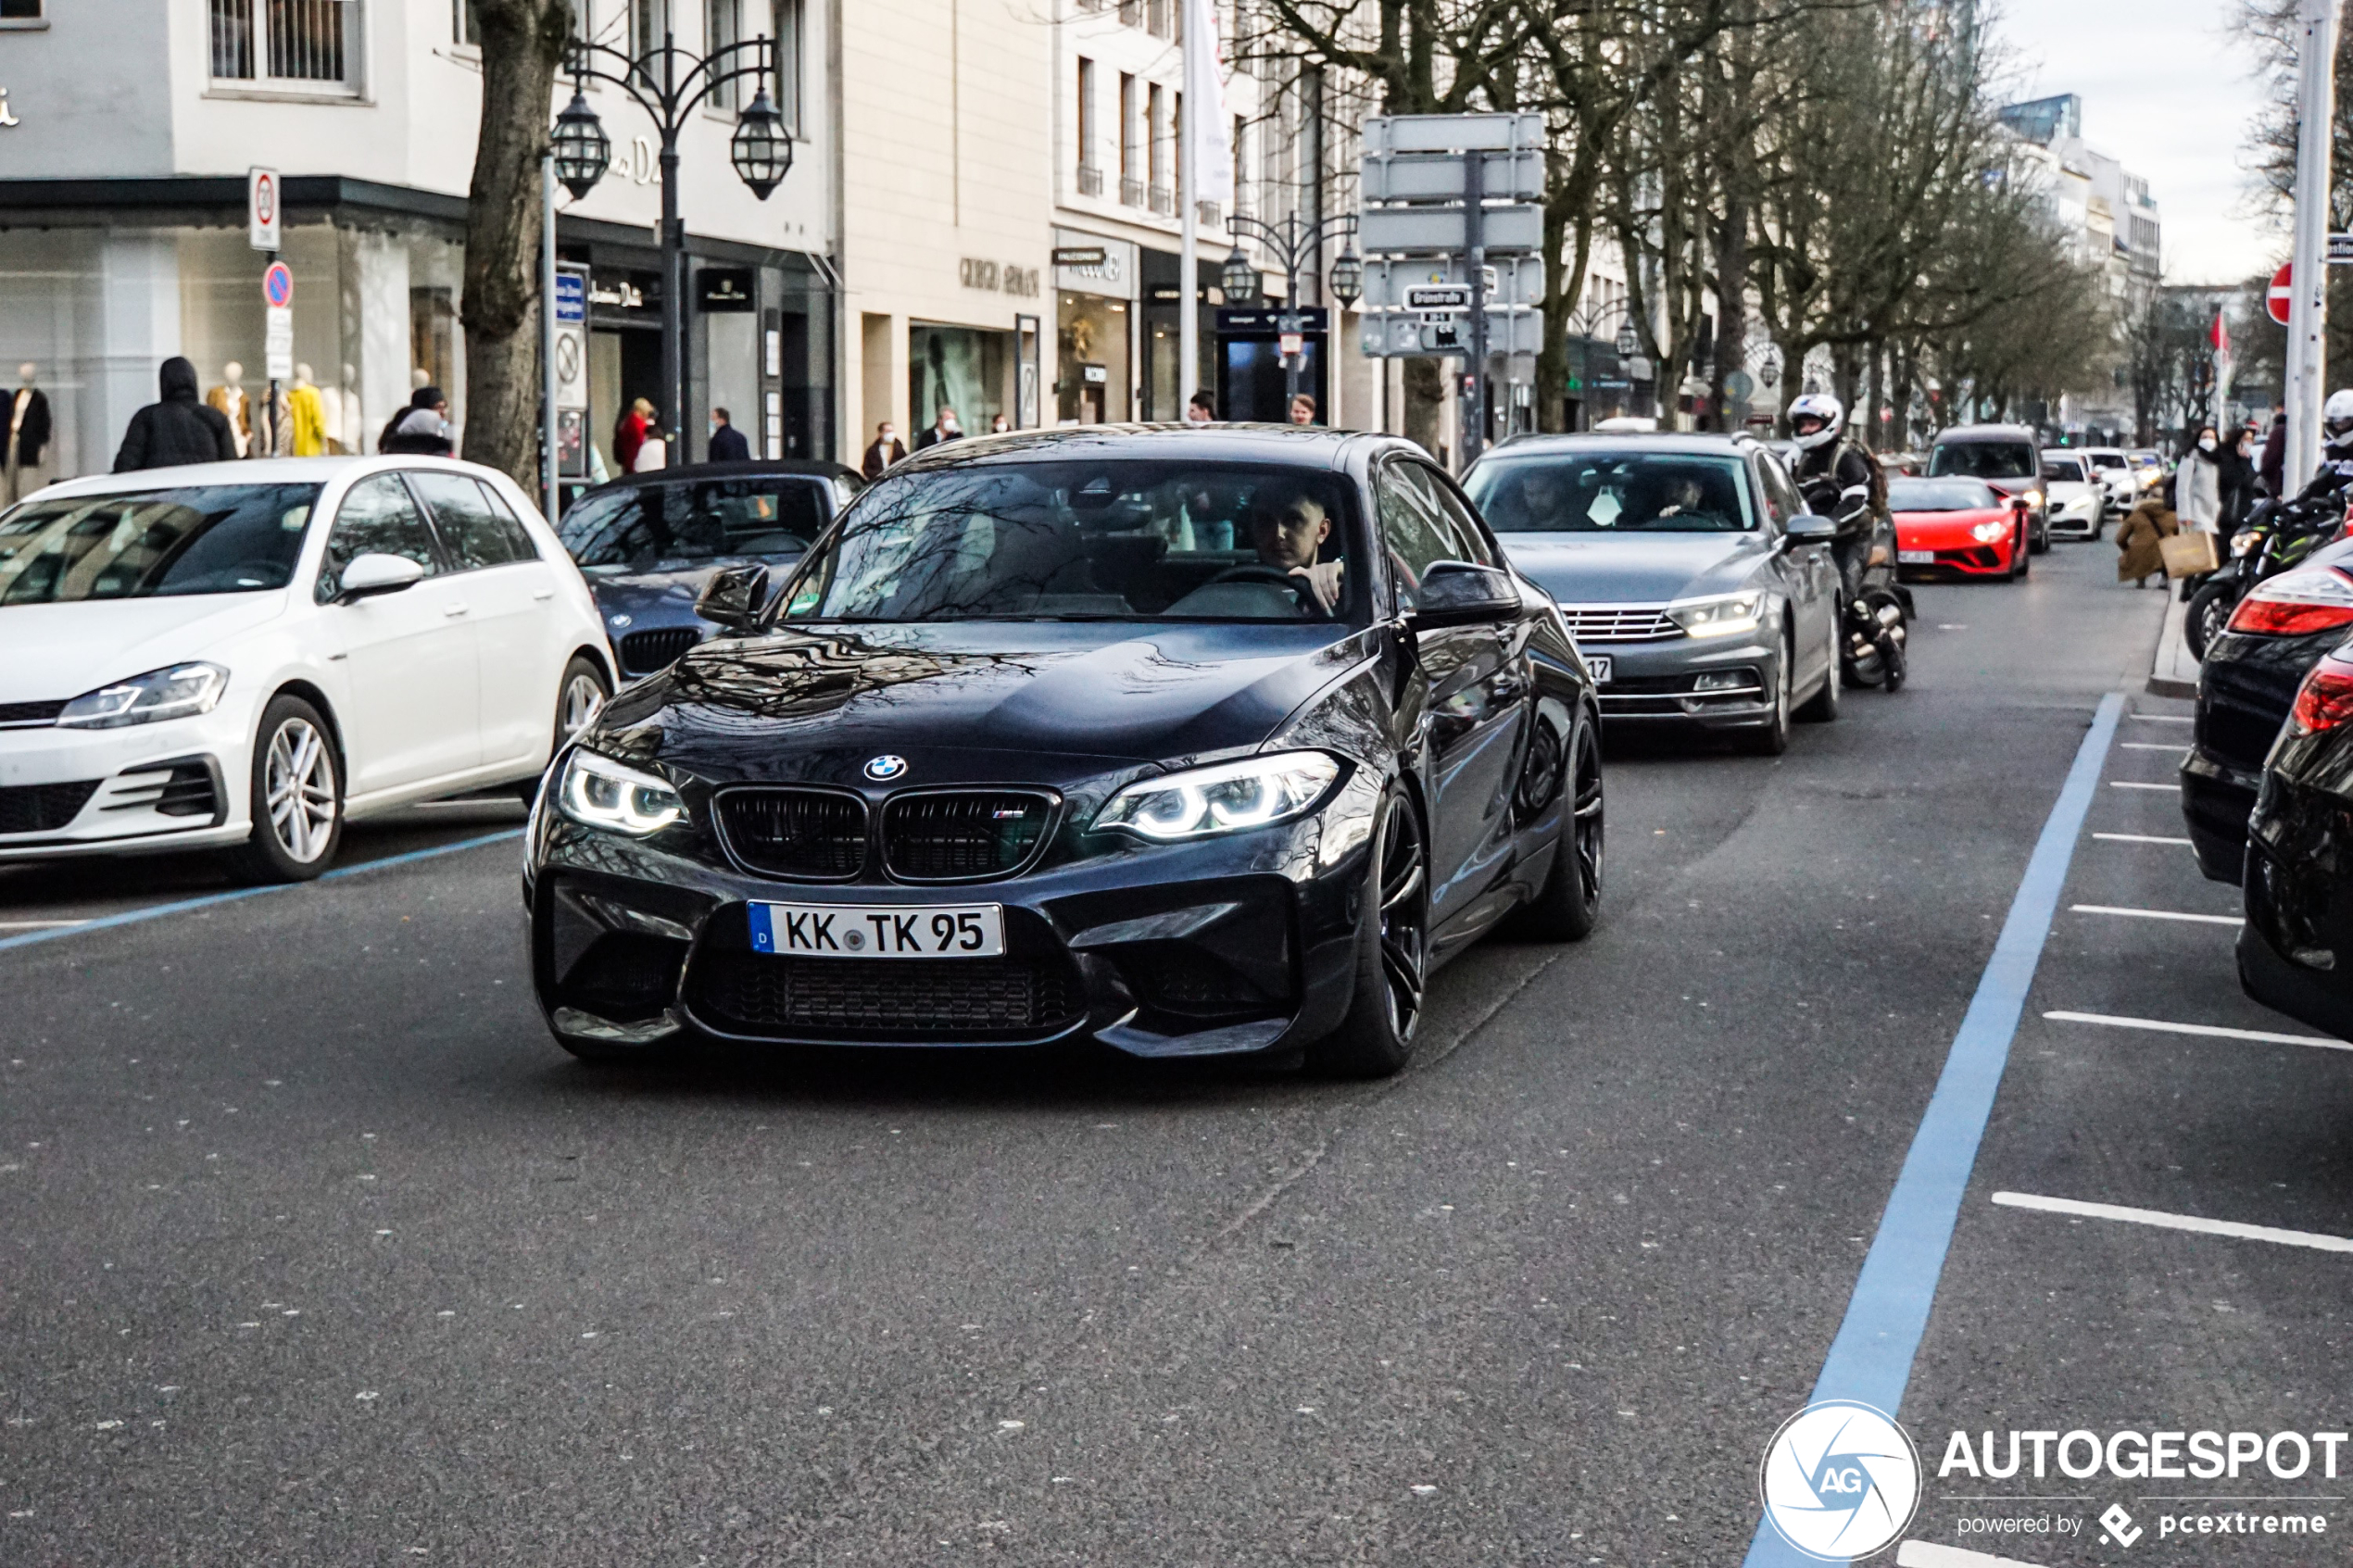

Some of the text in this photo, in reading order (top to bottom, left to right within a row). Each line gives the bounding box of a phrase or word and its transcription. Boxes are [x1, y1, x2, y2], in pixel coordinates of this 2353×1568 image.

[758, 933, 768, 944] D
[786, 911, 984, 951] KK TK 95
